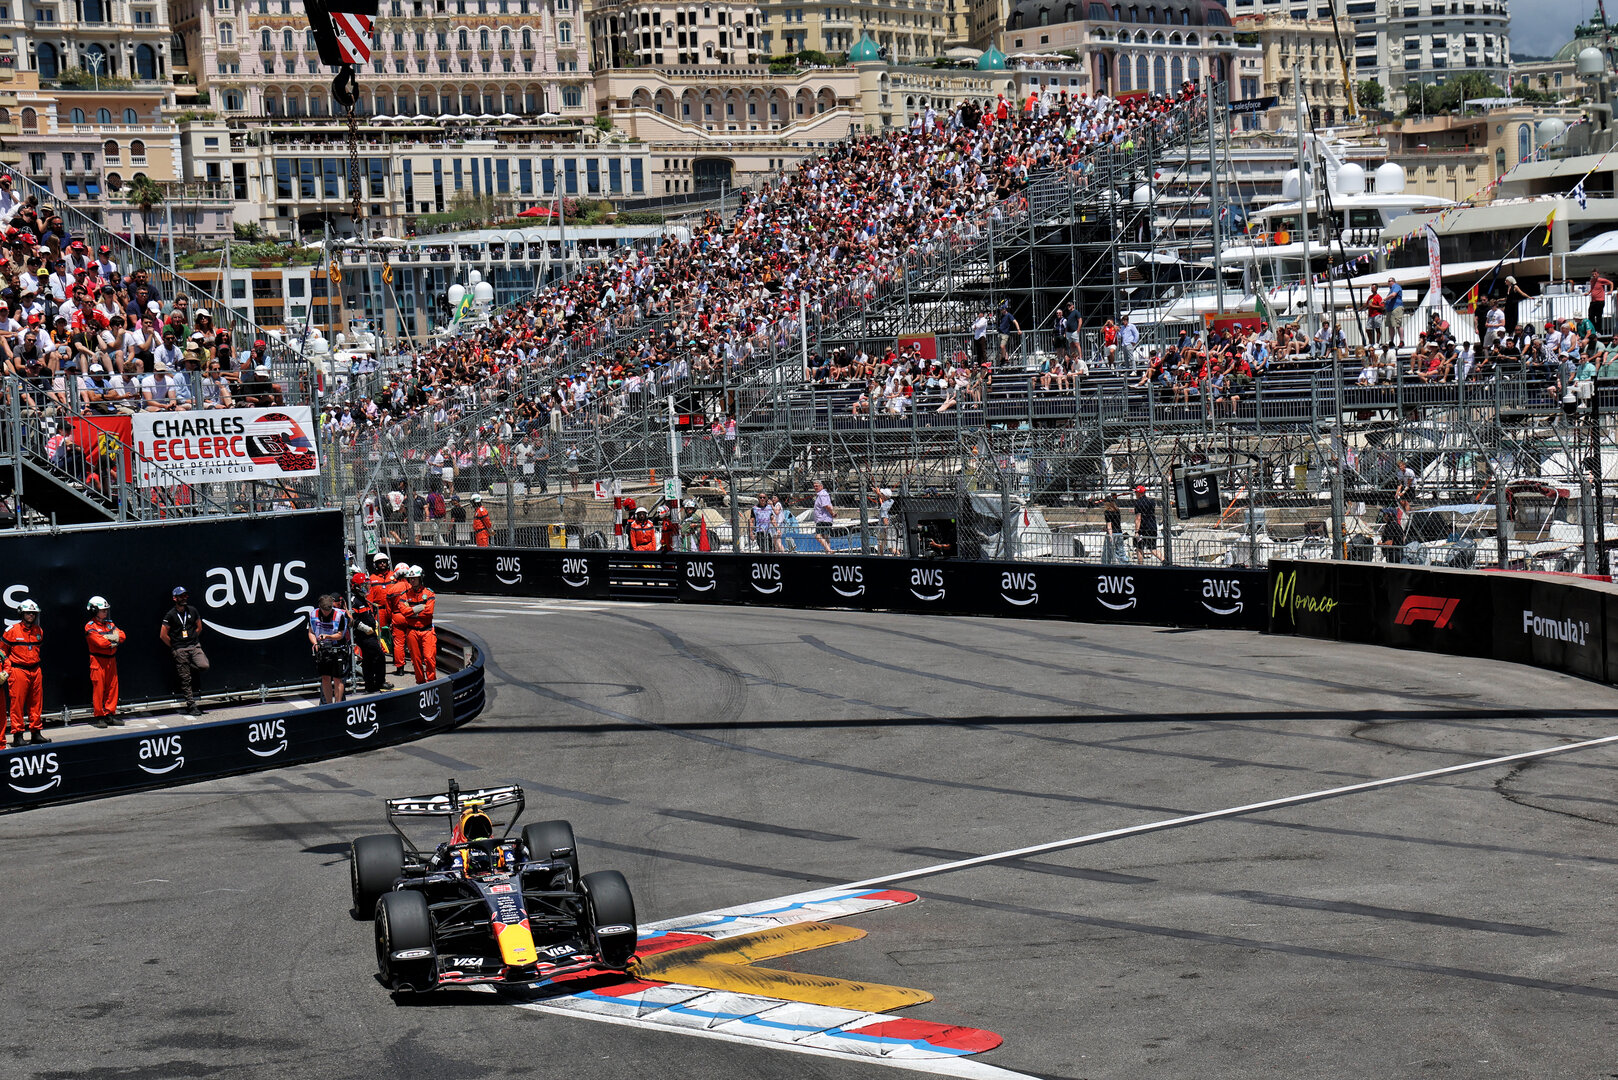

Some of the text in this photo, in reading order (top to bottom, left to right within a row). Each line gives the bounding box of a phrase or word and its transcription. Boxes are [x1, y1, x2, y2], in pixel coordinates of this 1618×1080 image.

[1234, 101, 1262, 111] salesforce
[152, 416, 245, 438] CHARLES
[138, 435, 246, 463] LECLERC
[150, 465, 254, 479] MARCHE FAN CLUB
[164, 459, 240, 470] THE OFFICIAL
[435, 554, 458, 570] aws
[496, 556, 521, 573] aws
[562, 558, 588, 575] aws
[686, 561, 715, 578] aws
[751, 562, 781, 580] aws
[832, 565, 863, 583] aws
[911, 568, 944, 587] aws
[1001, 572, 1037, 591] aws
[205, 560, 310, 608] aws
[1097, 575, 1135, 595] aws
[1202, 578, 1241, 599] aws
[1272, 570, 1338, 626] Monaco
[1394, 595, 1460, 629] F1
[419, 687, 440, 709] aws
[346, 703, 377, 726] aws
[248, 719, 286, 743] aws
[139, 735, 182, 760] aws
[9, 752, 60, 779] aws
[544, 945, 577, 957] VISA
[453, 957, 484, 967] VISA
